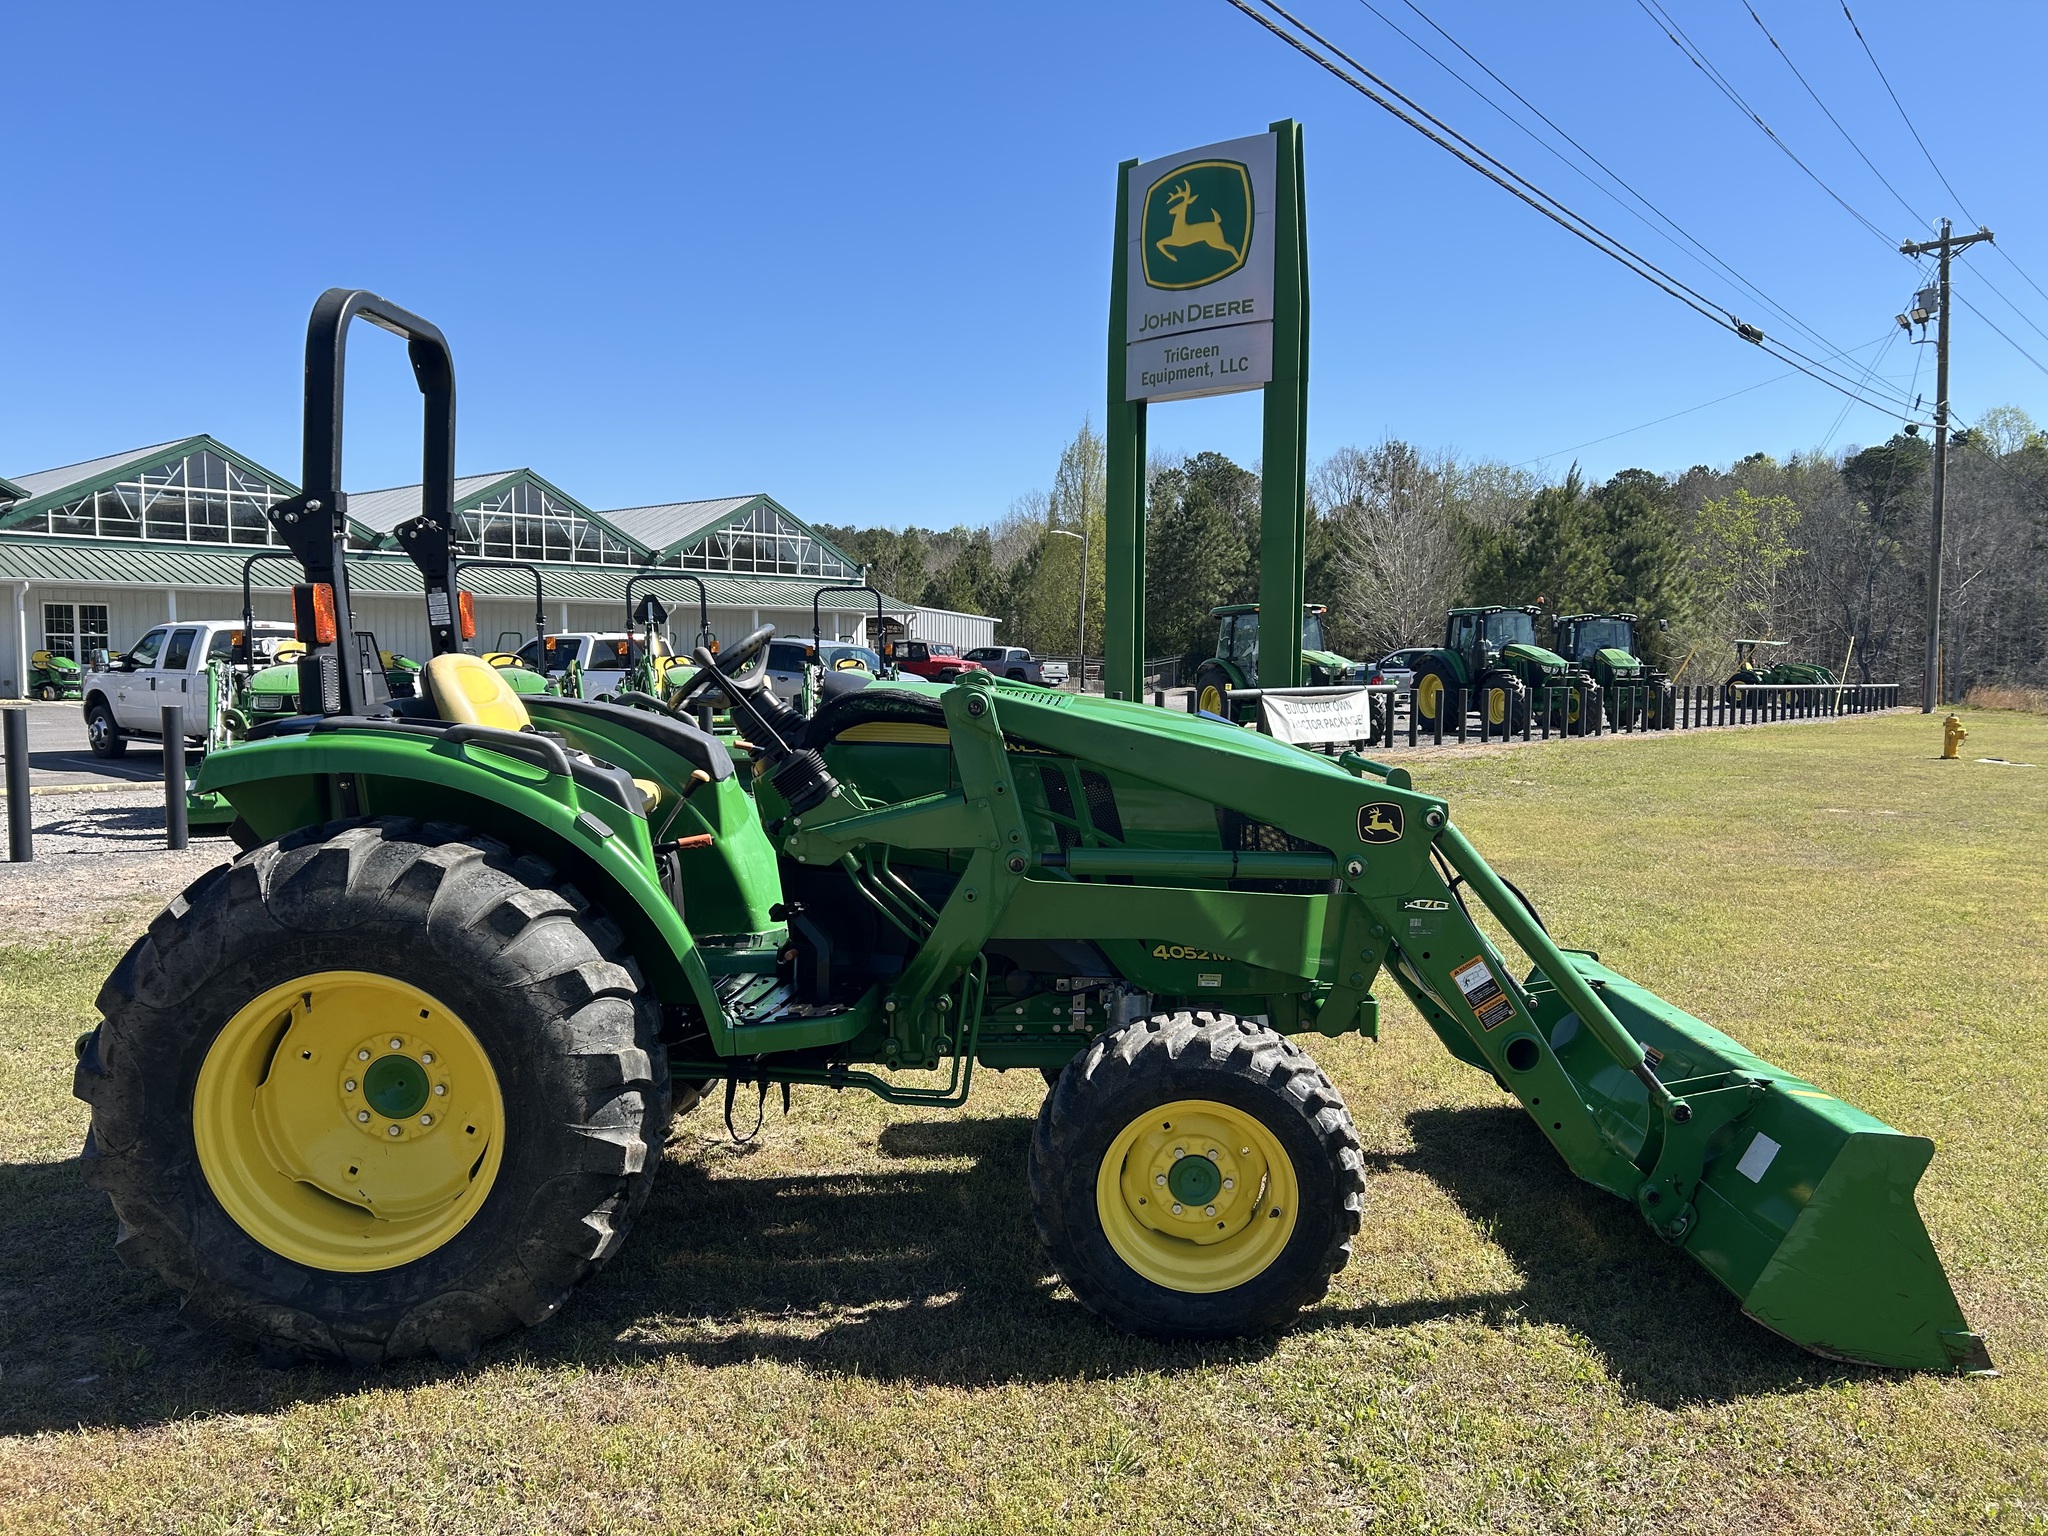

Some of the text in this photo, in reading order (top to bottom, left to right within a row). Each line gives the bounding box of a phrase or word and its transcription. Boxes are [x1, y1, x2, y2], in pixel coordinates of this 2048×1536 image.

[1139, 299, 1254, 332] JOHN DEERE
[1164, 345, 1219, 364] TriGreen
[1141, 357, 1249, 388] Equipment, LLC
[1284, 699, 1353, 714] BUILD YOUR OWN
